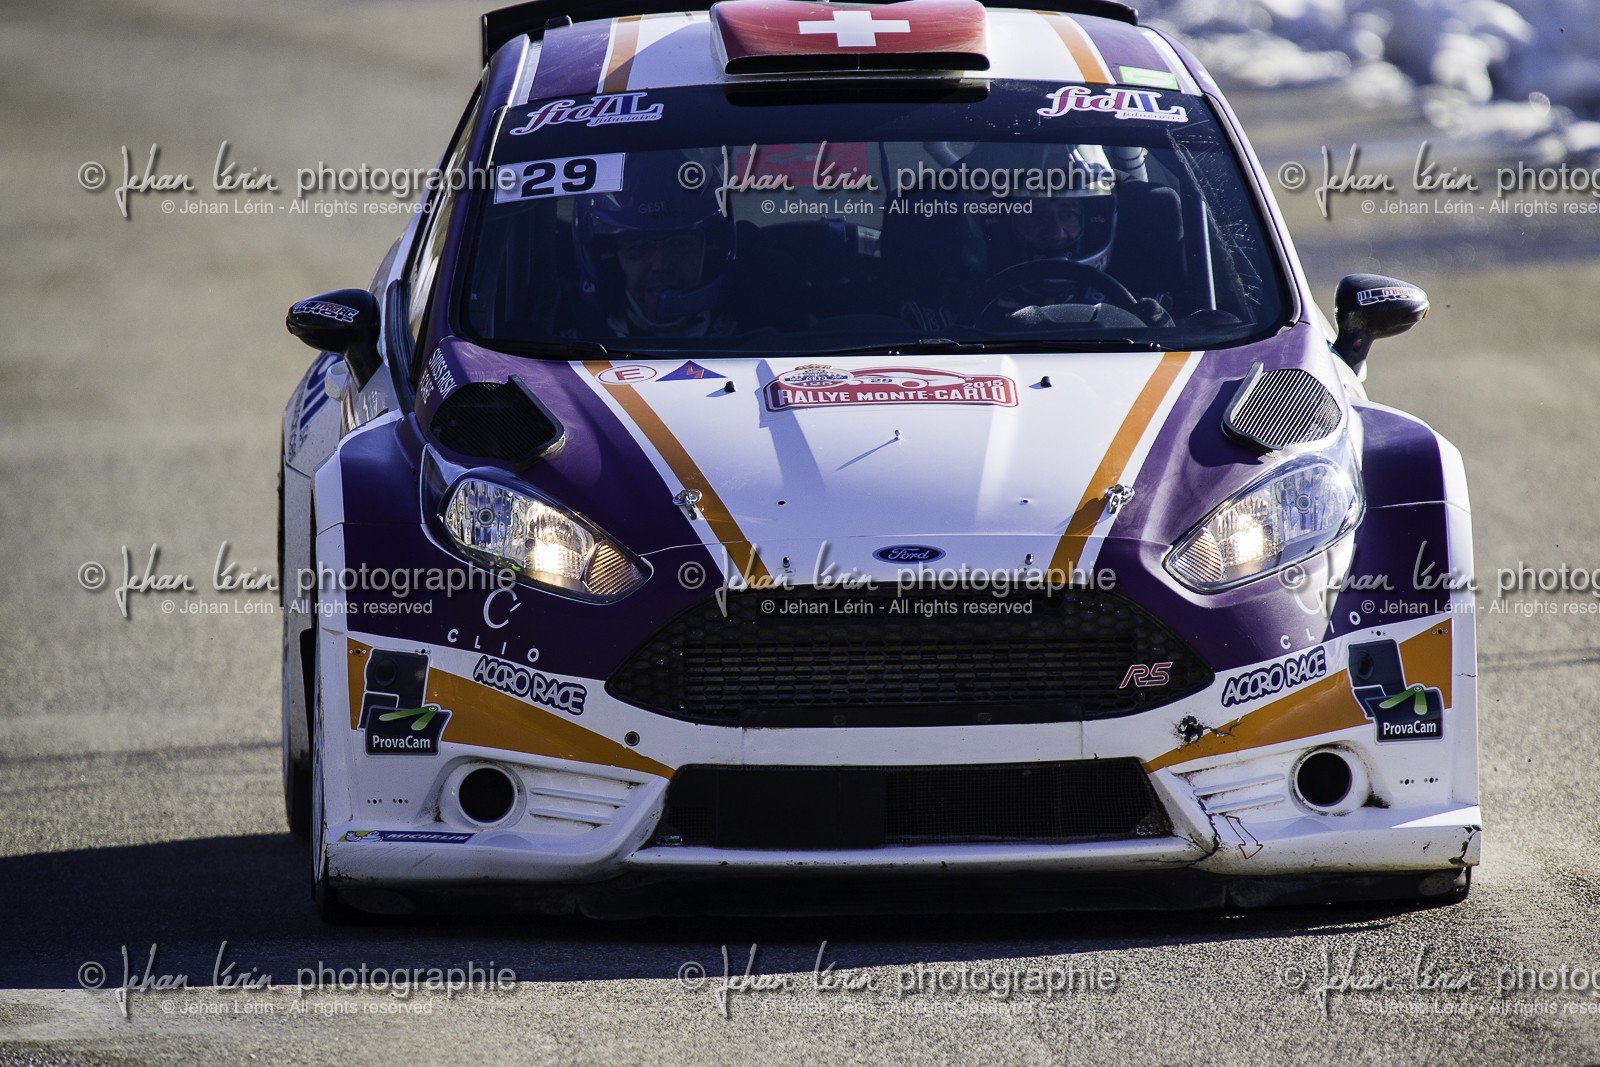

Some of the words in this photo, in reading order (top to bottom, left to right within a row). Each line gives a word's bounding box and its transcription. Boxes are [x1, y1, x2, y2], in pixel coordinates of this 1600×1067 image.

[521, 158, 597, 197] 29
[437, 370, 457, 399] RISK
[781, 389, 850, 403] RALLYE
[856, 386, 1007, 403] MONTE-CARLO
[963, 380, 1003, 389] 2015
[888, 547, 930, 560] Ford
[1280, 611, 1361, 650] CLIO
[447, 628, 540, 663] CLIO
[474, 656, 531, 697] ACCRO
[531, 673, 587, 715] RACE
[1222, 664, 1284, 707] ACCRO
[1285, 646, 1326, 687] RACE
[1382, 720, 1437, 736] ProvaCam
[372, 735, 431, 749] ProvaCam
[386, 833, 470, 841] MICHELIN
